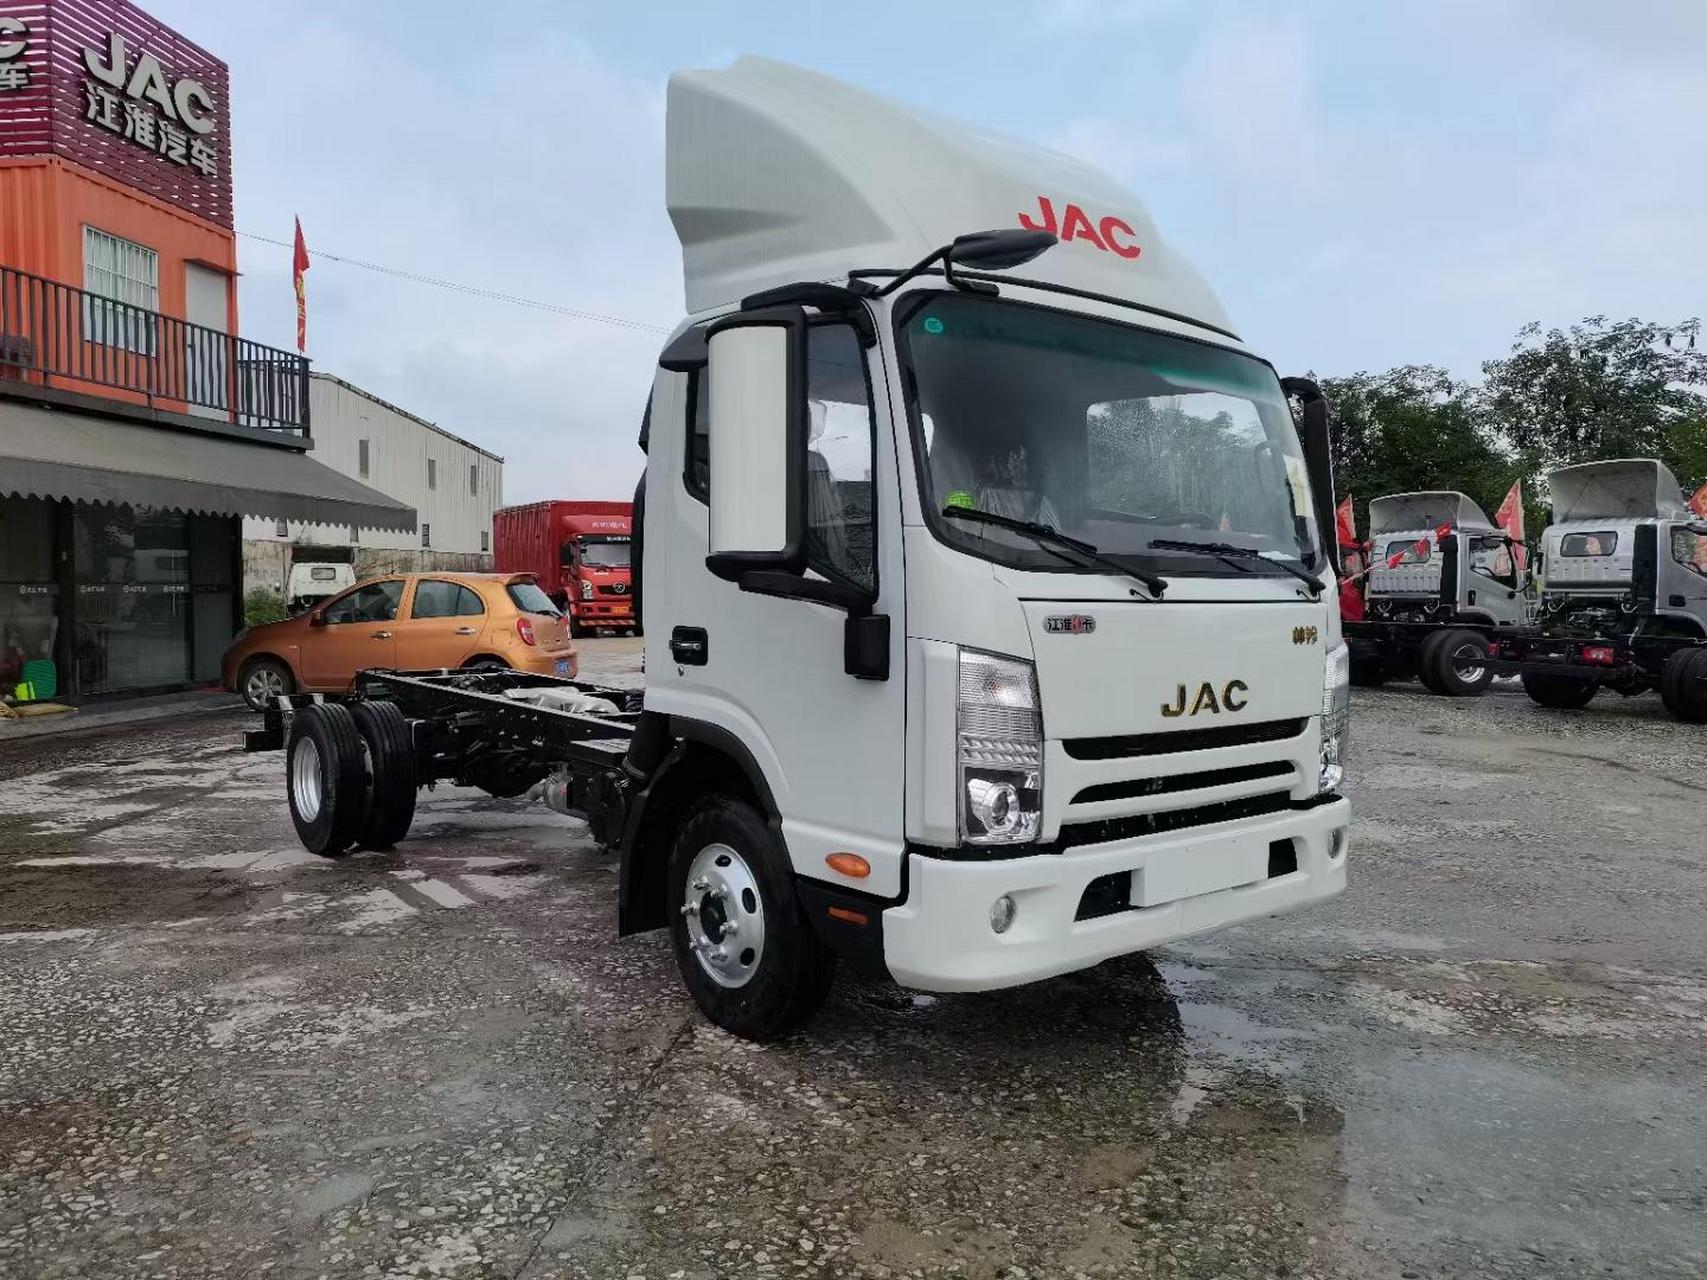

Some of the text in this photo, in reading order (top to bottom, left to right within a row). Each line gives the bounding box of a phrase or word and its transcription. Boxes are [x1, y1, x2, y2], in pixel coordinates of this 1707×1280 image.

[84, 32, 215, 134] JAC
[84, 79, 217, 175] 江淮汽车
[1018, 196, 1141, 259] JAC
[1160, 679, 1249, 718] JAC
